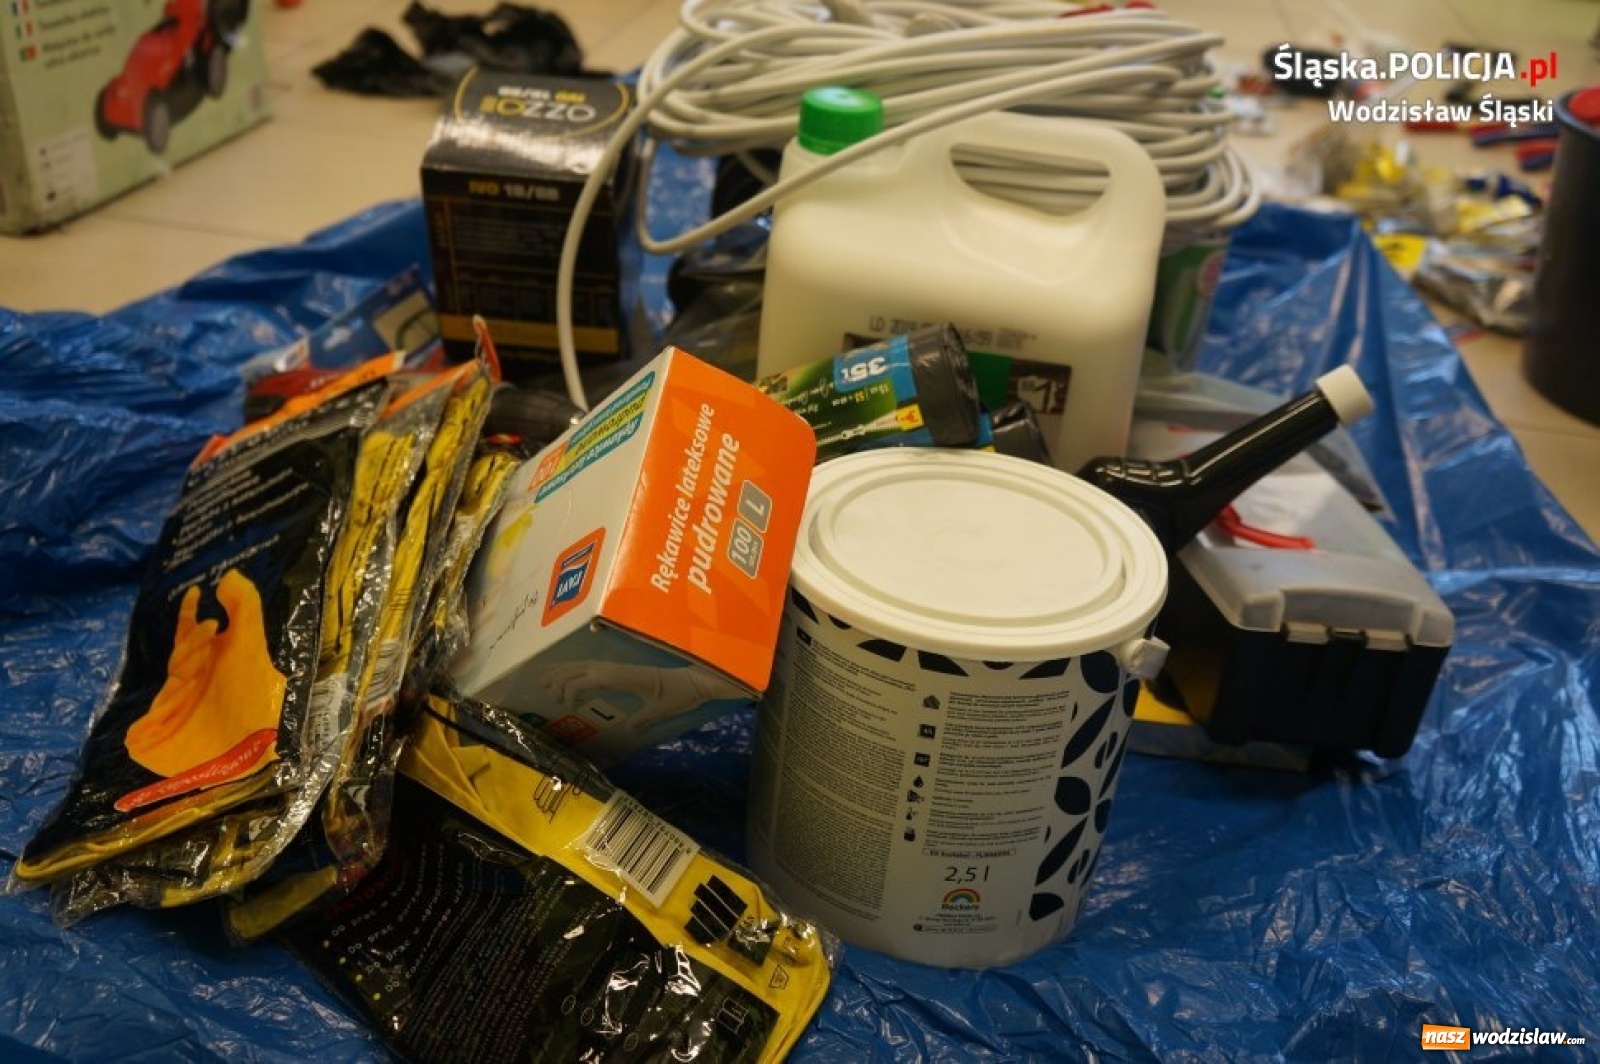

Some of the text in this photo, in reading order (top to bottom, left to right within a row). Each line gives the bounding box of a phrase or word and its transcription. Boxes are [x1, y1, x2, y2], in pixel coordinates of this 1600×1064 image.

[650, 402, 715, 593] Rękawice lateksowe
[687, 432, 740, 595] pudrowane
[746, 498, 765, 515] L
[731, 523, 752, 564] 100
[944, 865, 978, 885] 2,5
